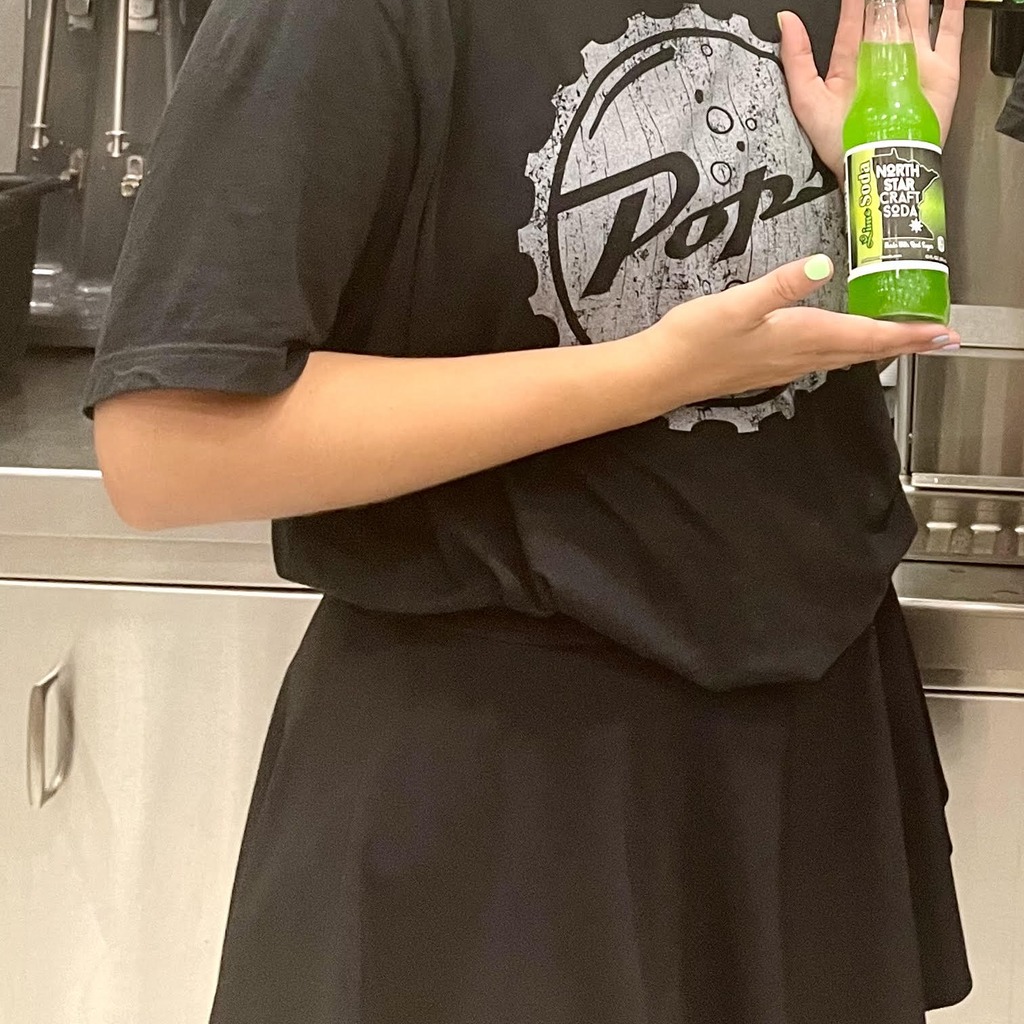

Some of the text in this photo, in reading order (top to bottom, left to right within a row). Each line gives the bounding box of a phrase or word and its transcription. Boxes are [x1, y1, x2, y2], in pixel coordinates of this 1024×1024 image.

[876, 163, 920, 178] NORTH
[883, 177, 915, 192] STAR
[858, 160, 874, 249] Lime Soda
[880, 191, 920, 204] CRAFT
[883, 204, 918, 218] SODA
